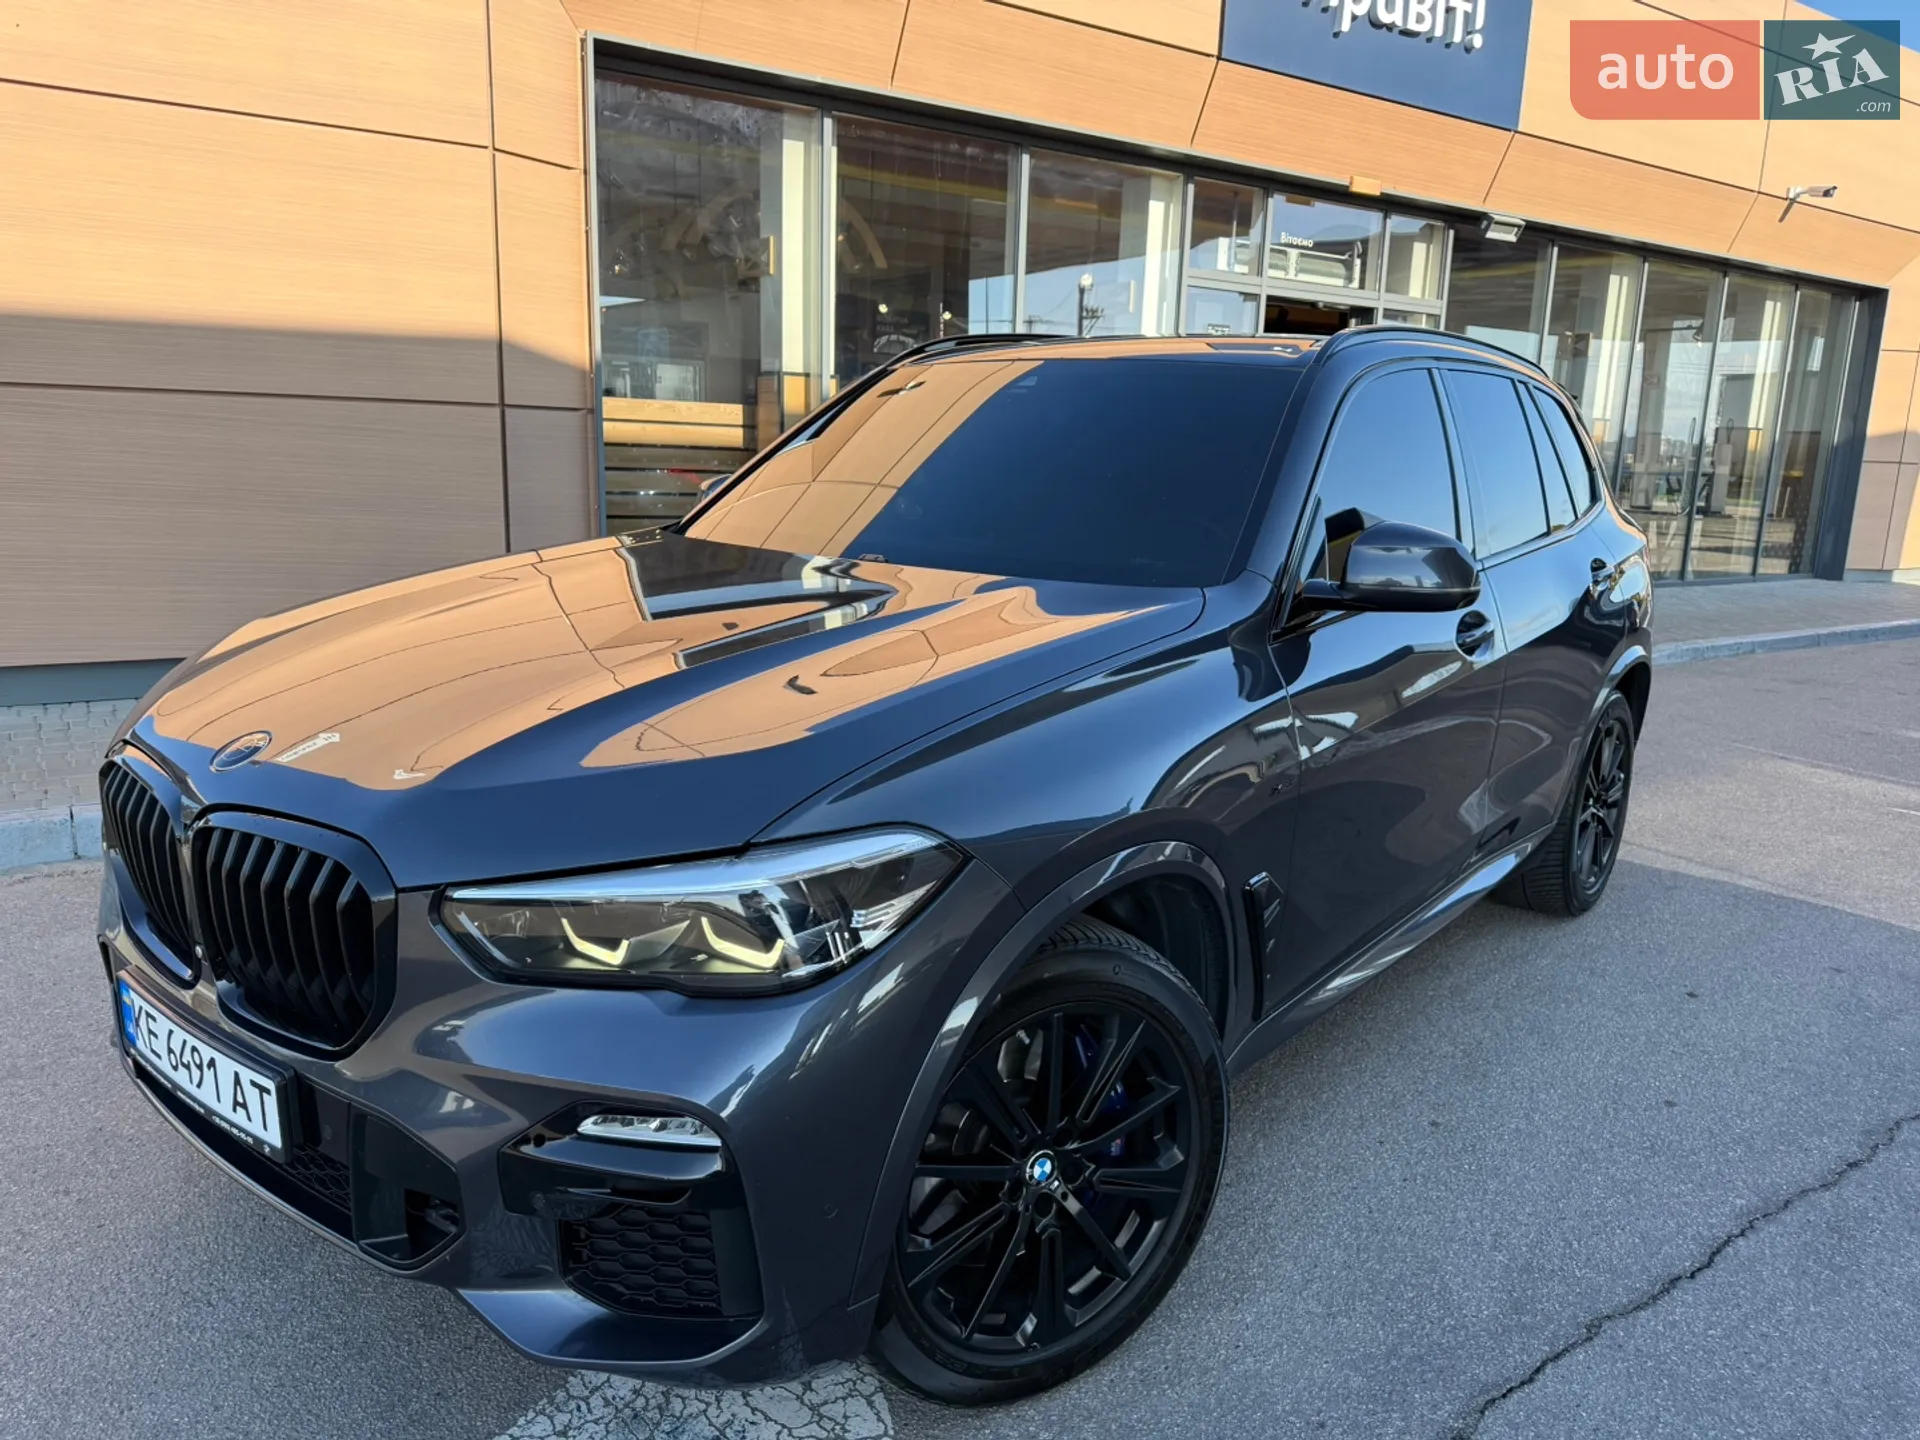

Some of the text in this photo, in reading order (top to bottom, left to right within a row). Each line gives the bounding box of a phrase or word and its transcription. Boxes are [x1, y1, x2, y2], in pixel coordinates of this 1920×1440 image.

[1328, 0, 1485, 49] ривіт!
[134, 1005, 163, 1061] KE
[166, 1029, 221, 1104] 6491
[232, 1070, 272, 1132] AT
